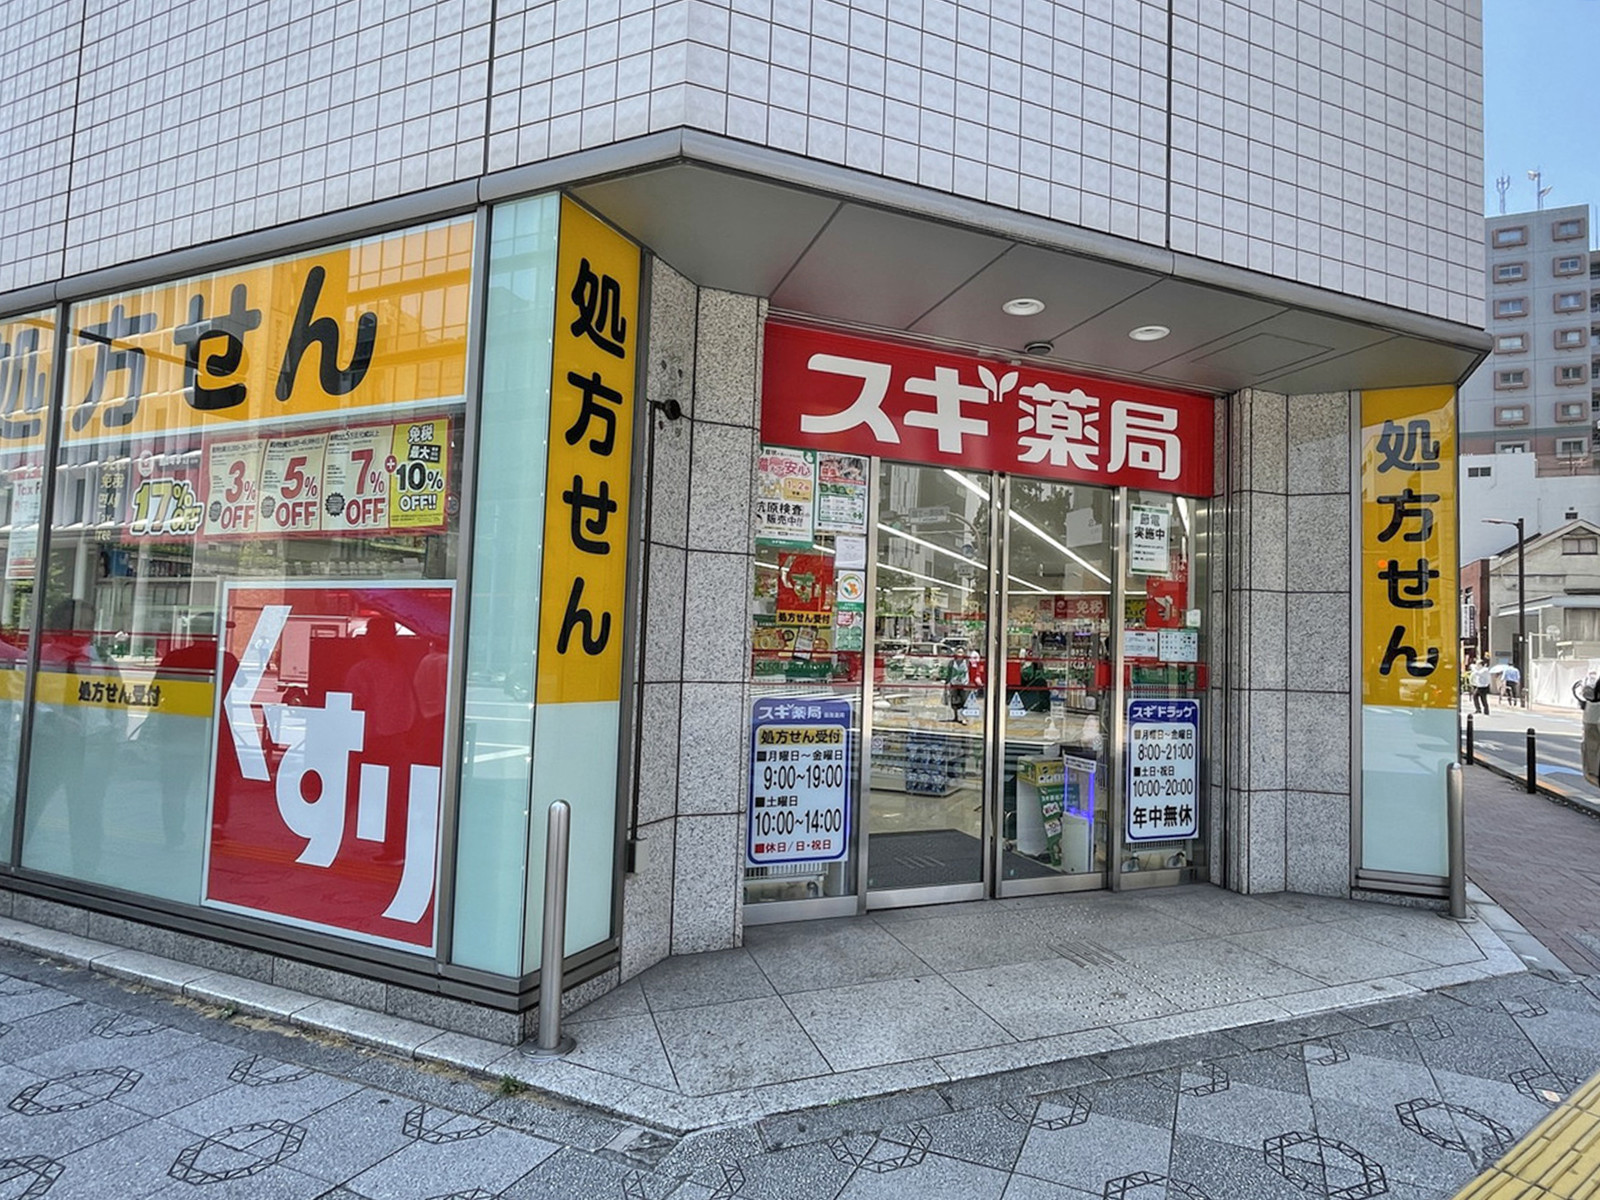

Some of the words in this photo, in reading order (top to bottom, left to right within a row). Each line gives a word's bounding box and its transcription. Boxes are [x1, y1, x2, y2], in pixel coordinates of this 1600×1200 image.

[800, 353, 1182, 481] スギ薬局
[408, 424, 434, 443] 免税
[556, 257, 626, 656] 処方せん
[225, 460, 256, 503] 3%
[281, 455, 318, 499] 5%
[351, 448, 385, 496] 7%
[395, 462, 443, 492] 10%
[132, 481, 194, 532] 17%
[275, 501, 318, 527] OFF
[346, 497, 386, 525] OFF
[400, 495, 437, 511] OFF!!
[170, 505, 203, 531] OFF
[221, 504, 256, 530] OFF
[1134, 526, 1166, 542] 実施中
[1376, 420, 1440, 677] 処方せん
[778, 612, 830, 625] 処方せん受付
[78, 680, 161, 707] 処方せん受付
[758, 703, 822, 720] スギ薬局
[1132, 704, 1196, 719] スギドラッグ
[761, 729, 841, 745] 処方せん受付
[224, 605, 441, 924] くすり
[767, 795, 798, 808] 土曜日
[1132, 804, 1193, 829] 年中無休
